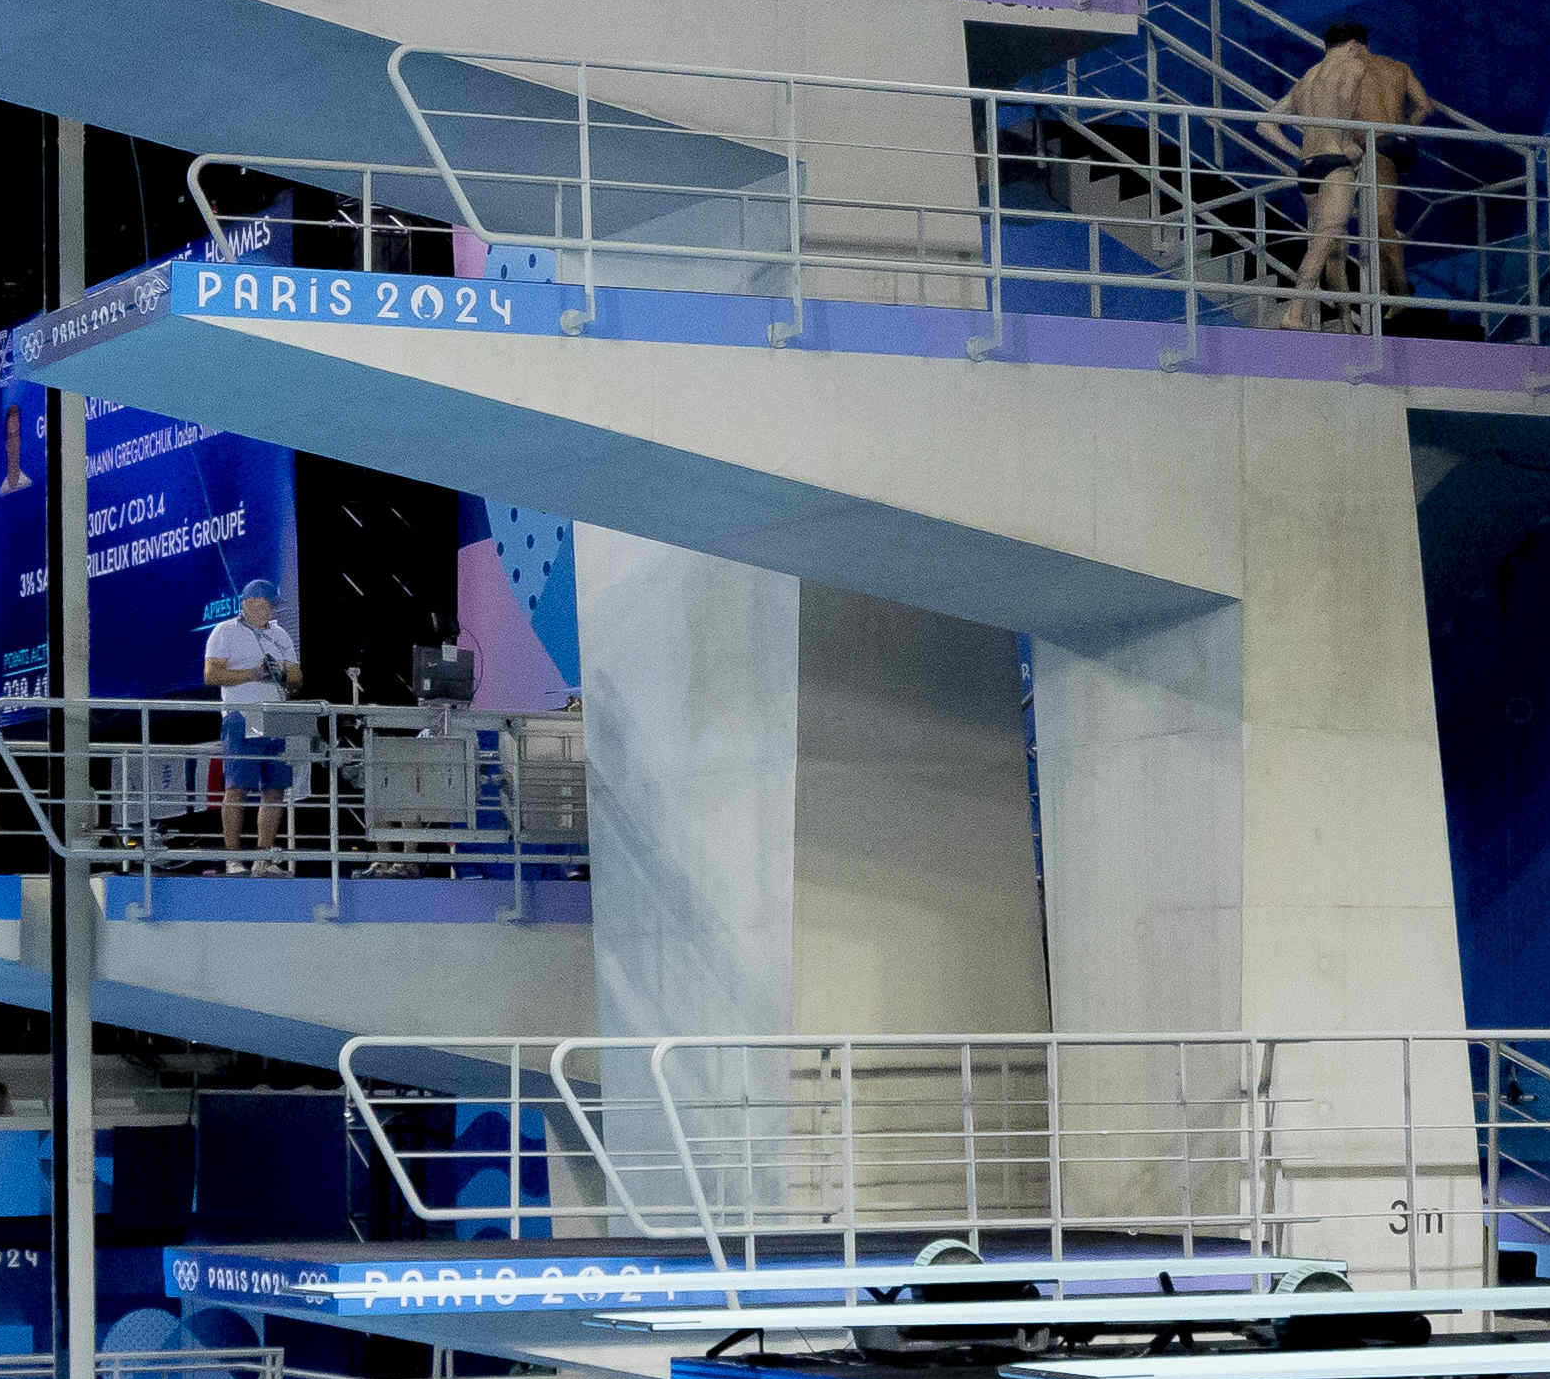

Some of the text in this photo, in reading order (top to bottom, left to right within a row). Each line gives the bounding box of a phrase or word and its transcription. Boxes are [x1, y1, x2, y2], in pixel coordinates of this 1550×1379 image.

[91, 299, 126, 330] 2024
[198, 271, 511, 325] PARIS 2024
[128, 498, 145, 525] CD
[148, 492, 165, 519] 3.4
[131, 517, 190, 566] RENVERSÉ
[192, 501, 245, 548] GROUPÉ
